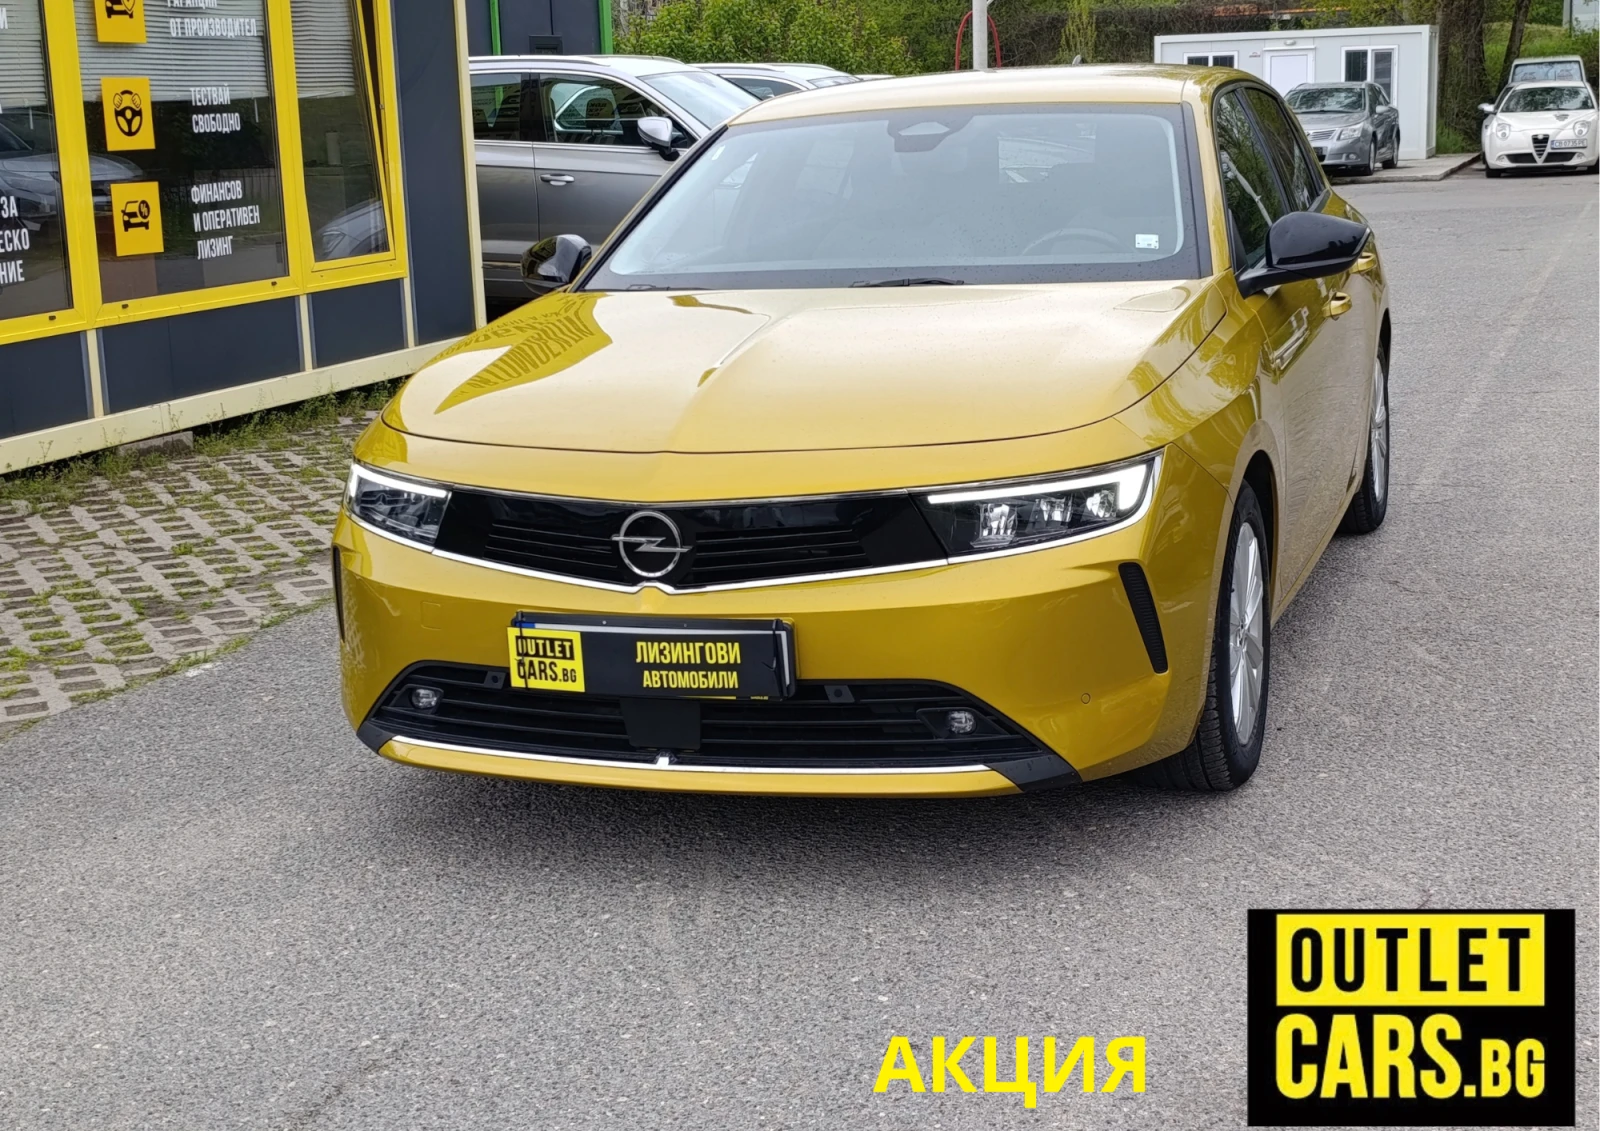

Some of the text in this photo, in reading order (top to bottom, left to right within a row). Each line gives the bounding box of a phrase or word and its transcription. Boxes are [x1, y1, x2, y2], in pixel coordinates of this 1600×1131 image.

[170, 18, 257, 39] ОТ ПРОИЗВОДИТЕЛ
[190, 83, 231, 106] ТЕСТВАЙ
[192, 112, 241, 134] СВОБОДНО
[190, 180, 243, 205] ФИНАНСОВ
[0, 196, 18, 218] ЗА
[193, 204, 260, 233] И ОПЕРАТИВЕН
[197, 235, 233, 260] ЛИЗИНГ
[517, 638, 572, 658] OUTLET
[636, 641, 741, 664] ЛИЗИНГОВИ
[517, 659, 577, 683] CARS.BG
[643, 670, 739, 689] АВТОМОБИЛИ
